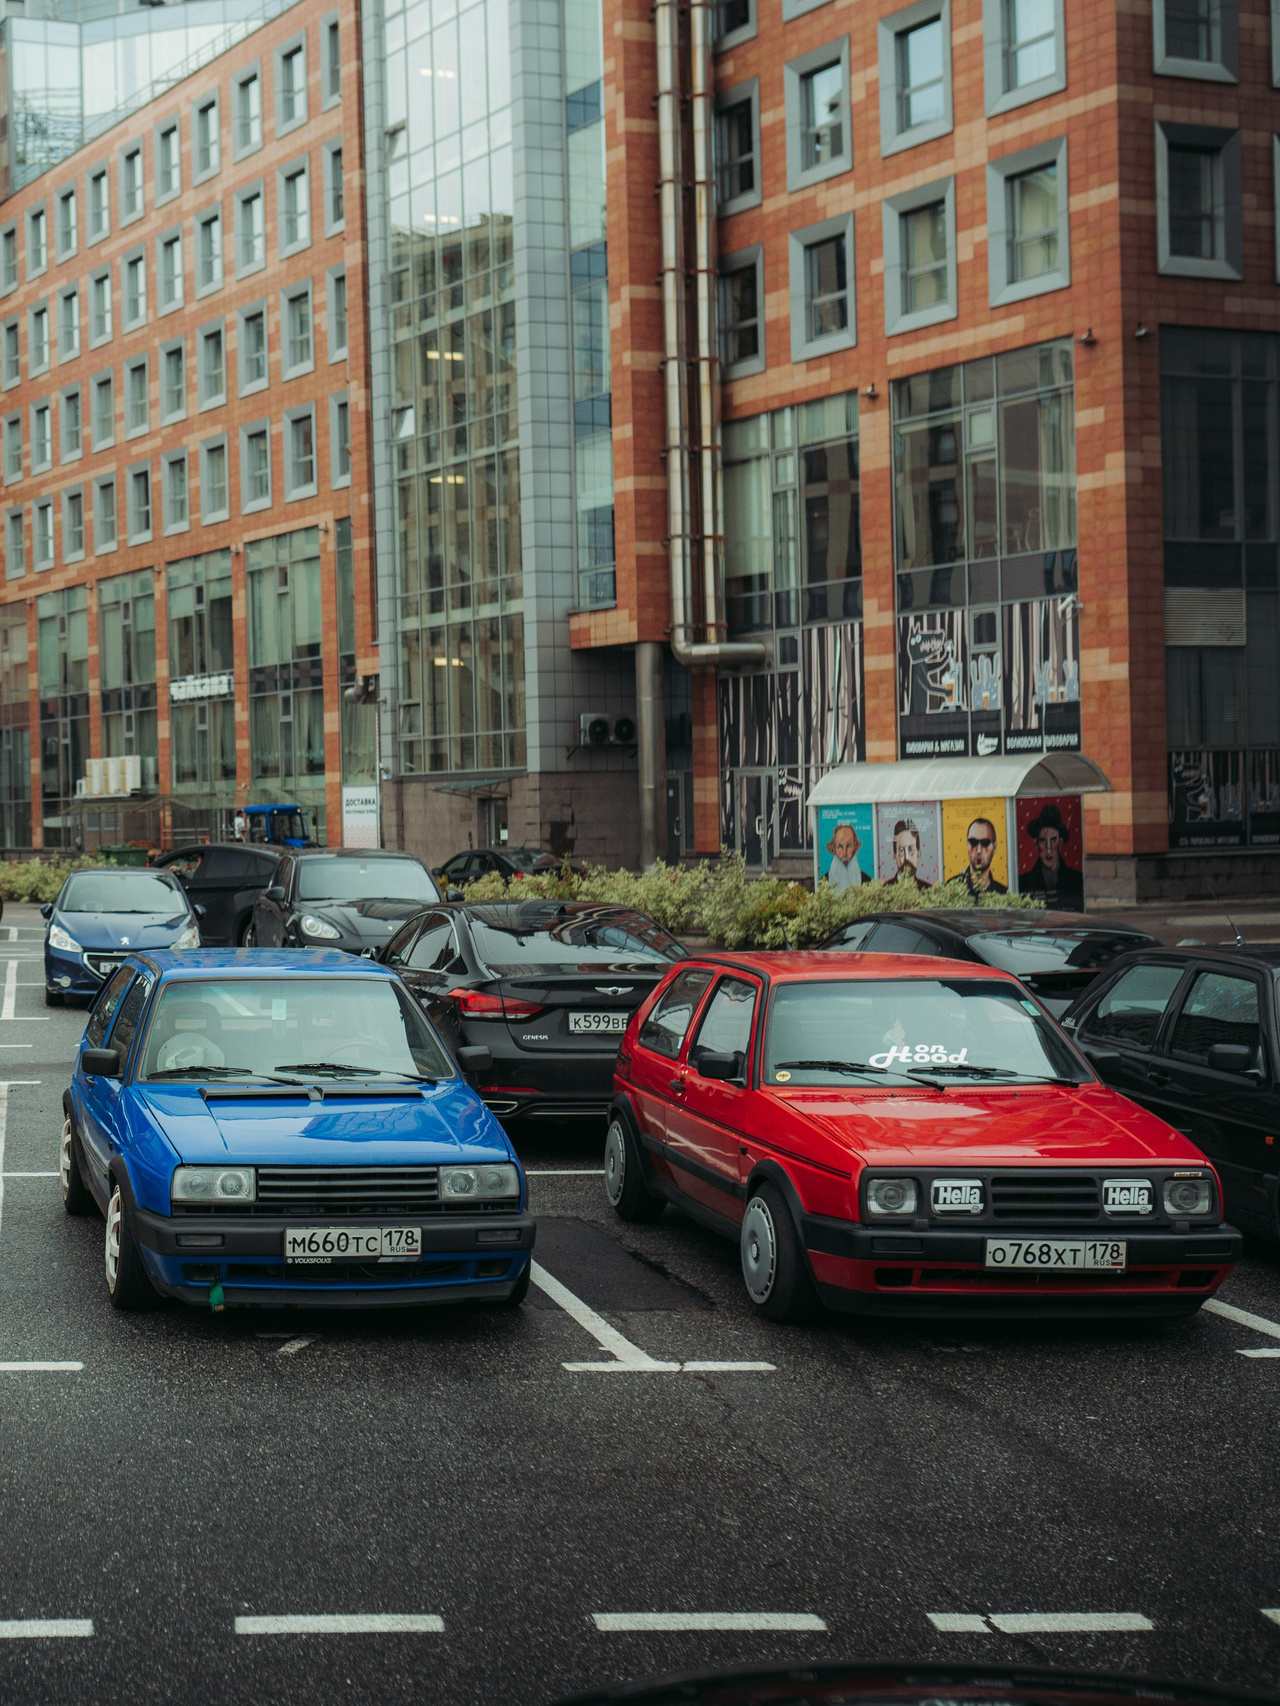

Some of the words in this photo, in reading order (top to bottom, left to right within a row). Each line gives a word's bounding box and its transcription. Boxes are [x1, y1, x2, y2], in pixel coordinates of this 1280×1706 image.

[345, 798, 376, 807] ДОСТАВКА
[869, 1046, 969, 1069] Hood
[915, 1044, 948, 1054] on
[938, 1186, 980, 1204] Hella
[1108, 1187, 1149, 1205] Hella
[383, 1230, 414, 1246] 178
[1088, 1243, 1120, 1260] 178
